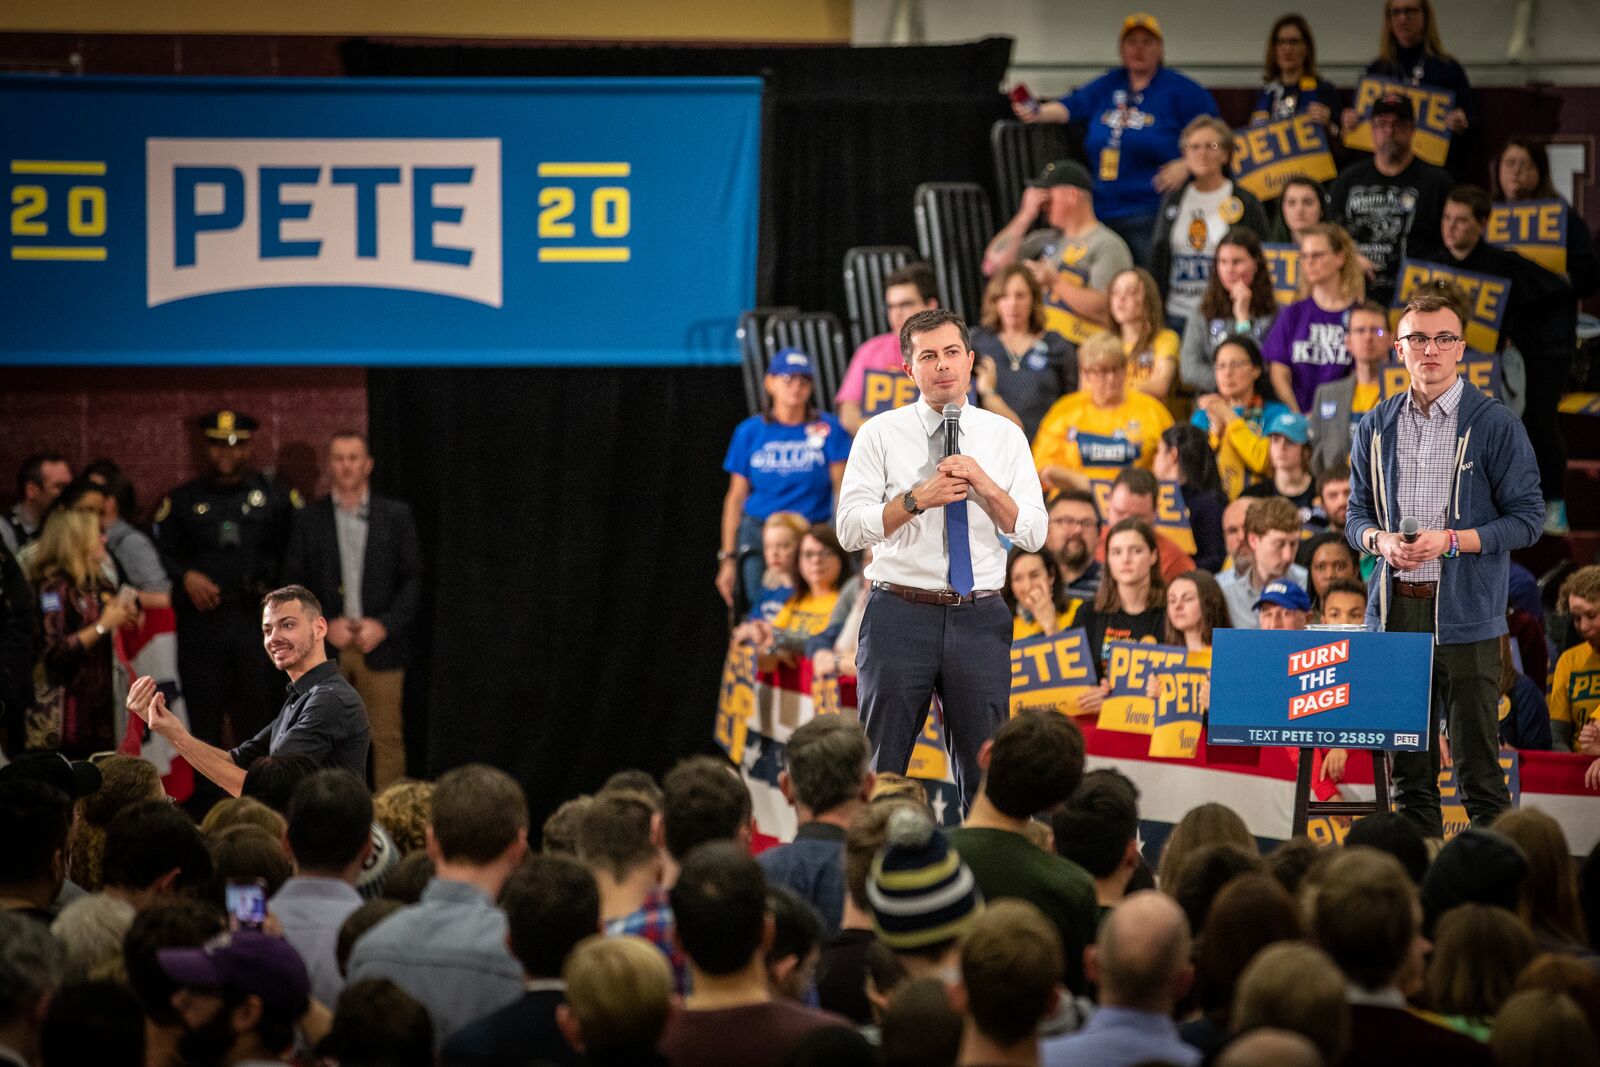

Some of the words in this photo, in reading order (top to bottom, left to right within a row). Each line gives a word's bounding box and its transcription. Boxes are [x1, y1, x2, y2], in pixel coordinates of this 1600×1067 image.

[1231, 114, 1321, 173] PETE
[11, 186, 107, 236] 20
[173, 165, 475, 268] PETE
[538, 187, 631, 238] 20
[1486, 203, 1562, 243] ETE
[1400, 264, 1504, 321] PTE
[865, 373, 921, 412] PE
[1011, 636, 1088, 687] ETE
[1290, 642, 1347, 672] TURN
[1158, 673, 1207, 717] PET
[1299, 667, 1336, 691] THE
[1292, 687, 1346, 716] PAGE
[1248, 729, 1278, 741] TEXT
[1281, 731, 1313, 742] PETE
[1317, 731, 1335, 743] TO
[1339, 732, 1386, 744] 25859
[1396, 735, 1417, 744] PETE
